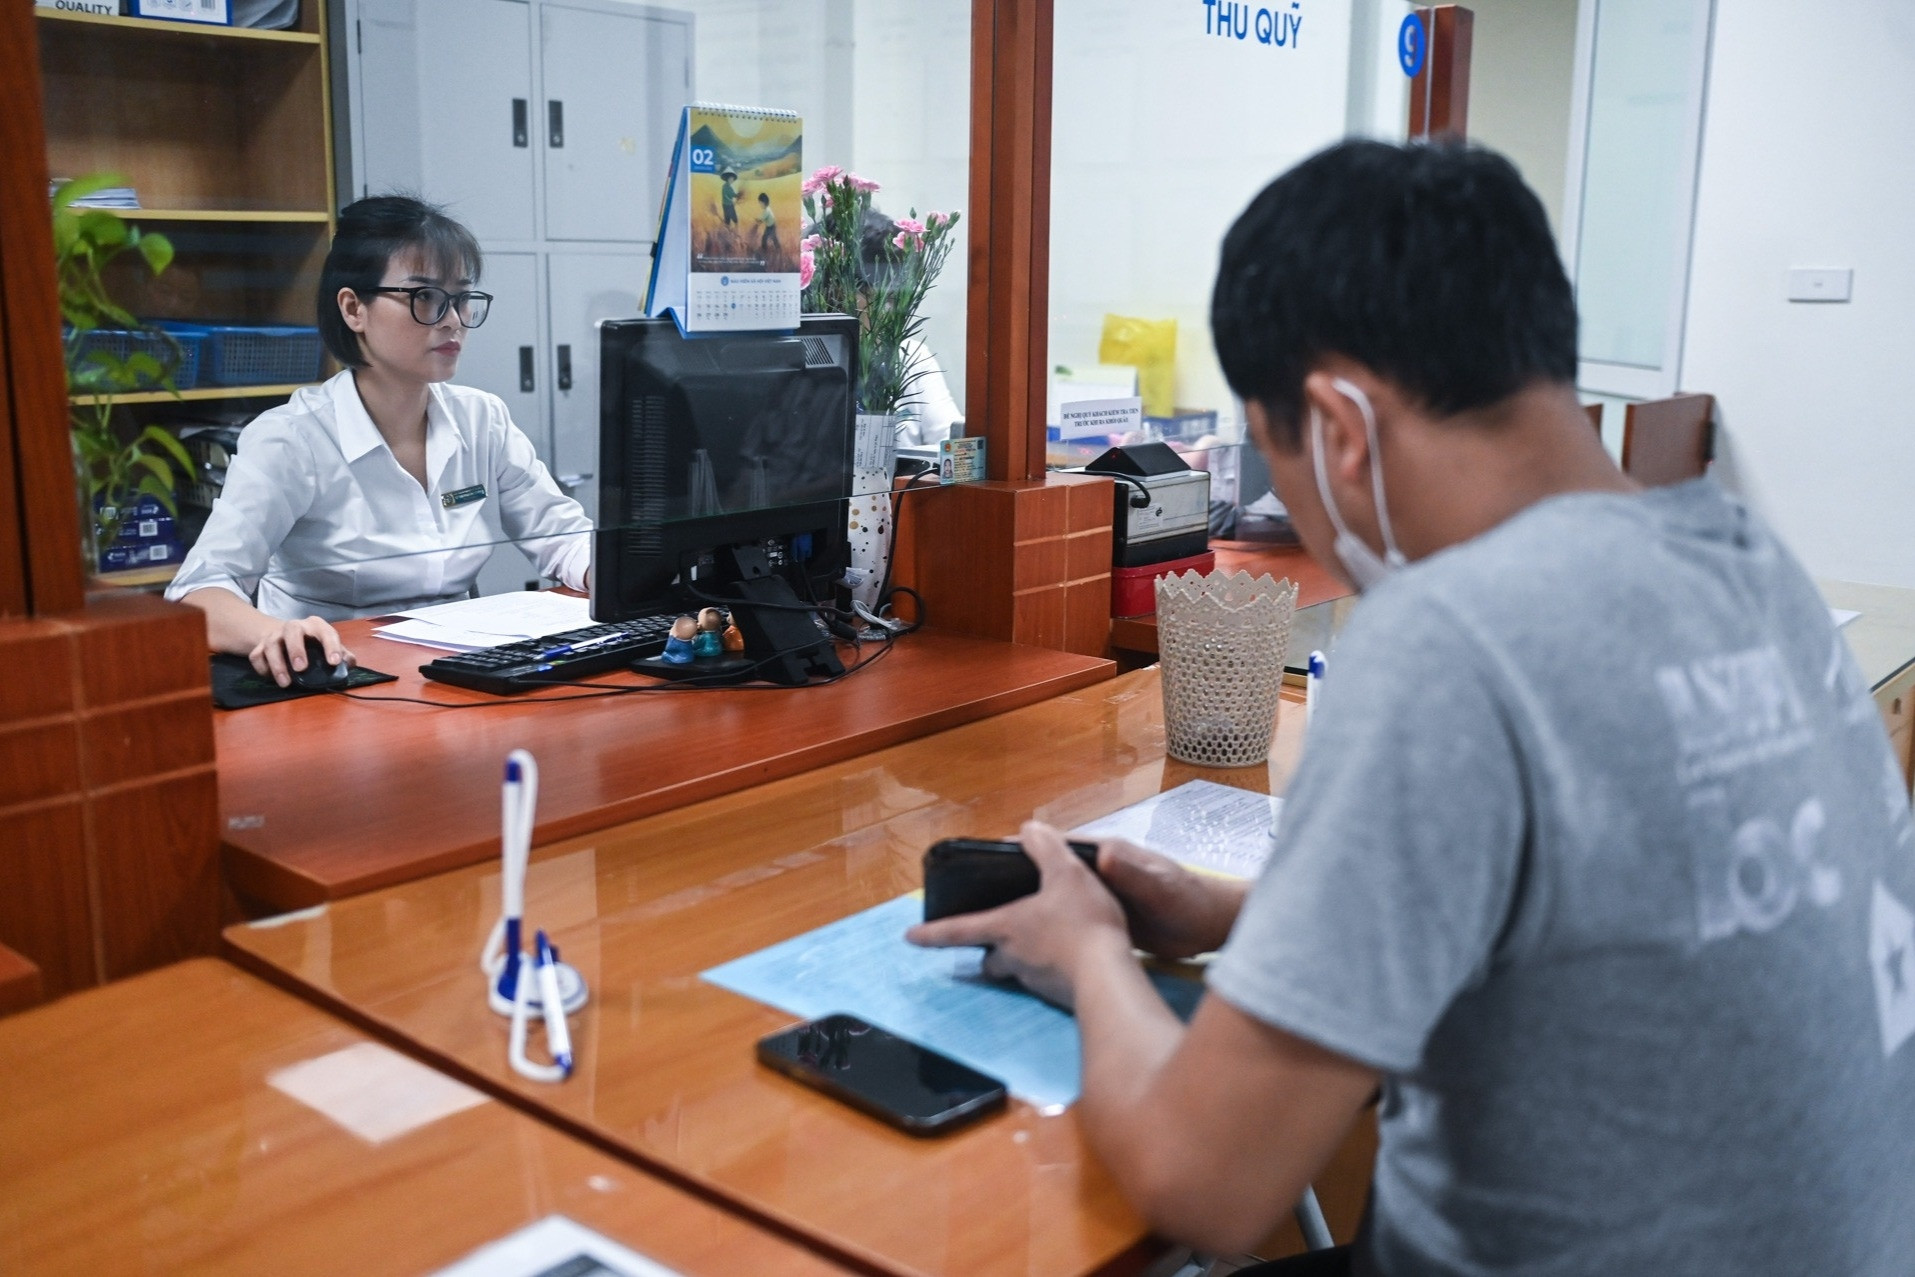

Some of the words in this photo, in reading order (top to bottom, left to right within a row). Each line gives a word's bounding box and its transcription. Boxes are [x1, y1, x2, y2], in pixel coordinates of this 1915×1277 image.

[1202, 0, 1248, 40] THU
[1255, 2, 1302, 48] QUỸ
[1404, 25, 1416, 68] 9
[693, 149, 714, 165] 02
